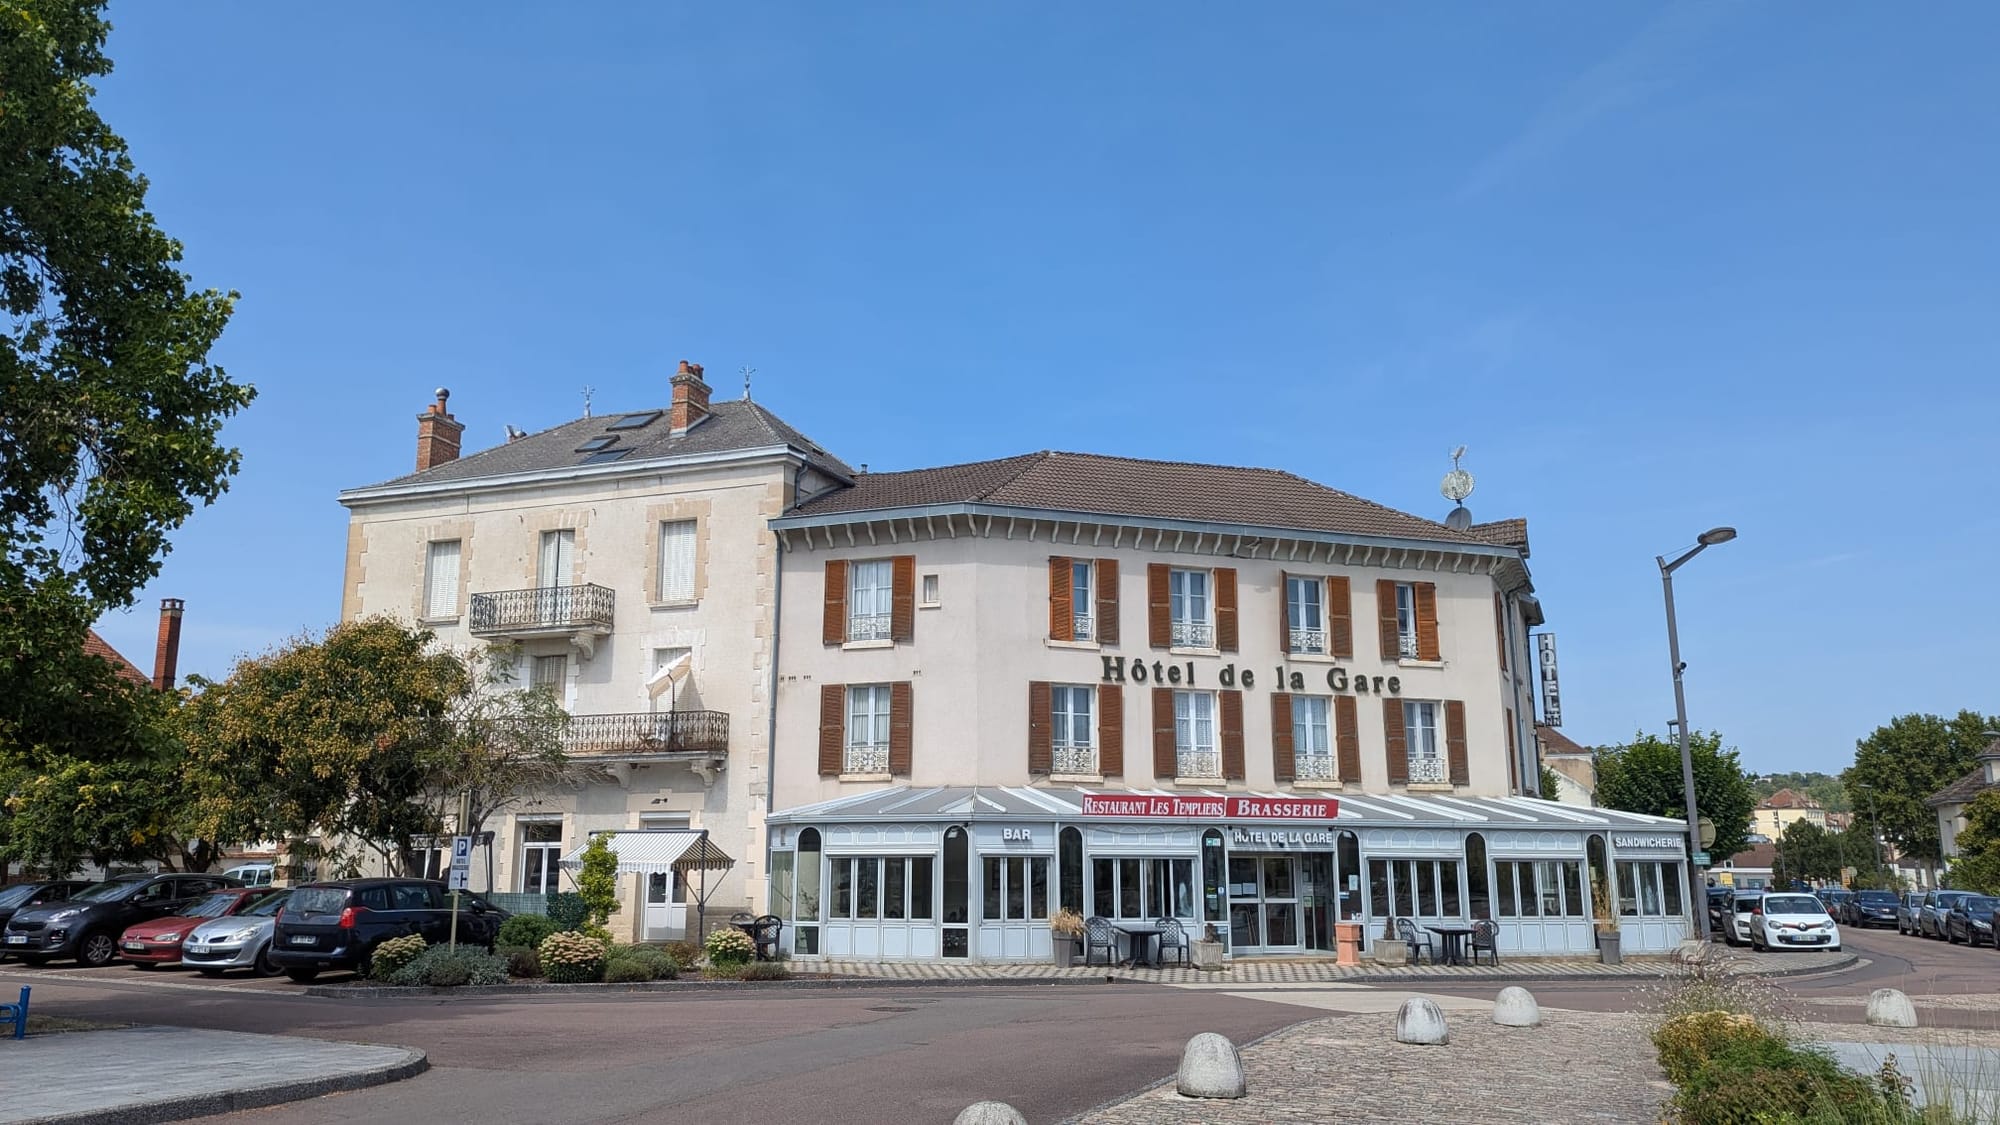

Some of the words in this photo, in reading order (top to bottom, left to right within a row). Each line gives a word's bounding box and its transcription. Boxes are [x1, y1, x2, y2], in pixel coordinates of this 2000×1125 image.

[1101, 656, 1195, 684] Hôtel
[1219, 663, 1254, 687] de
[1276, 666, 1304, 690] la
[1326, 667, 1400, 693] Gare
[1540, 633, 1559, 711] HOTEL
[1003, 829, 1031, 841] BAR
[1271, 832, 1285, 843] DE
[1289, 832, 1301, 843] LA
[1304, 832, 1333, 844] GARE
[458, 840, 466, 855] P
[1615, 837, 1682, 848] SANDWICHERIE
